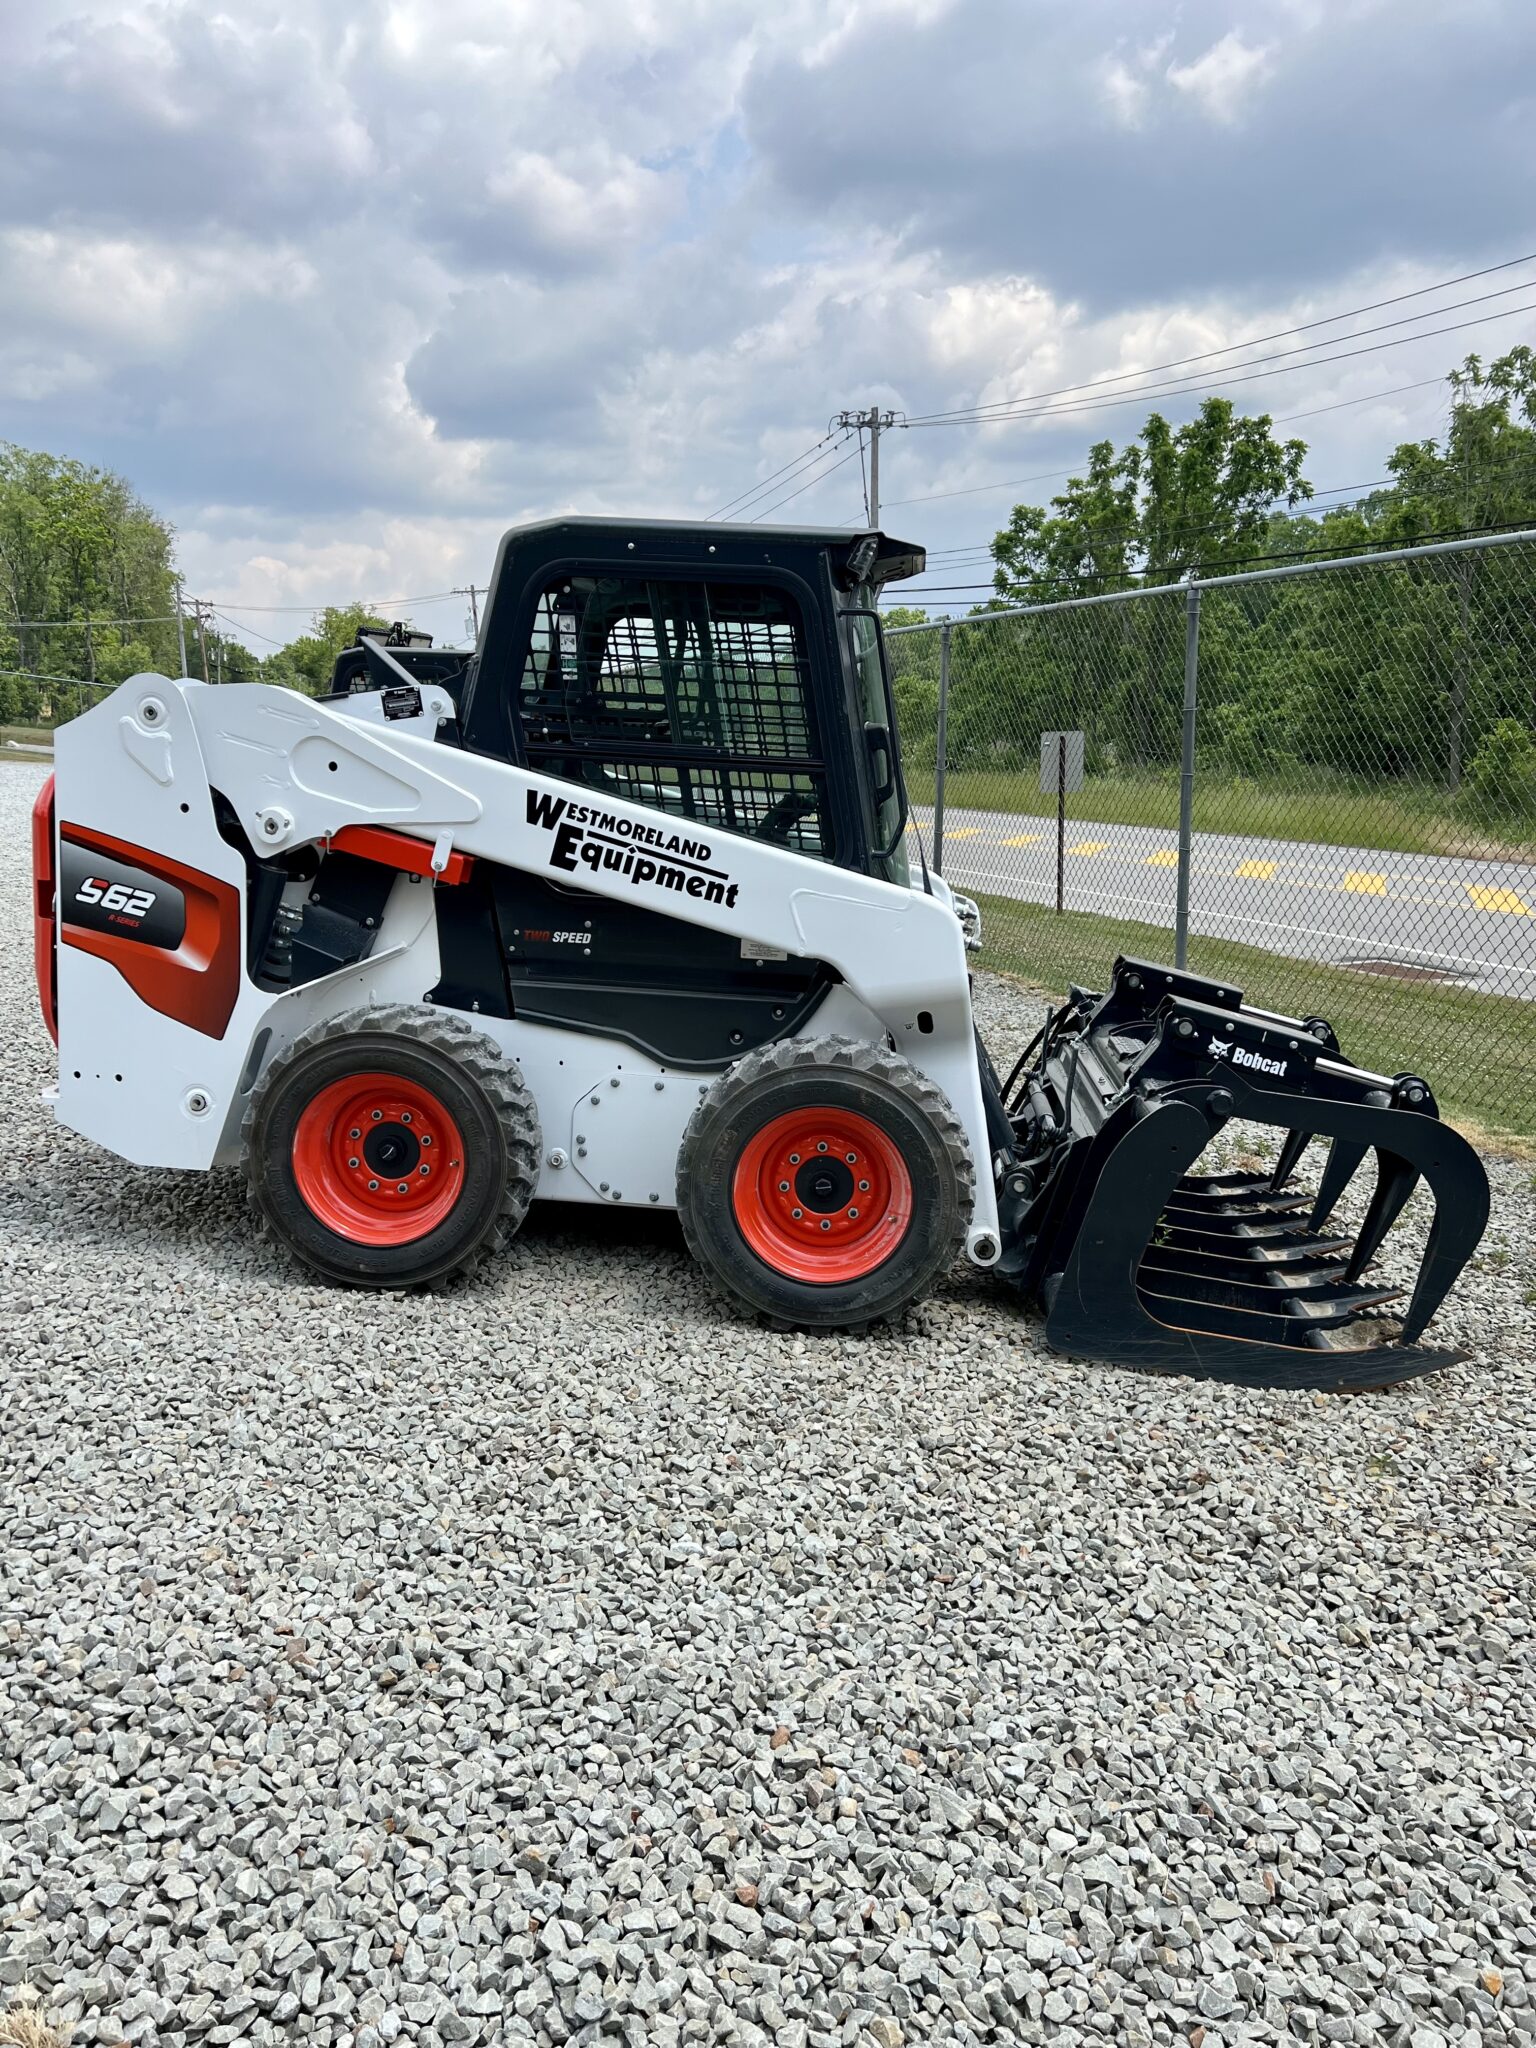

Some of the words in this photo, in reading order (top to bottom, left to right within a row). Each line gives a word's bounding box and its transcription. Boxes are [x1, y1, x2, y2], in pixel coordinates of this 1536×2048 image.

[526, 789, 712, 861] WESTMORELAND
[549, 822, 739, 909] Equipment
[75, 877, 157, 917] S62
[524, 929, 550, 942] TWO
[552, 931, 591, 944] SPEED
[1231, 1047, 1288, 1077] Bobcat
